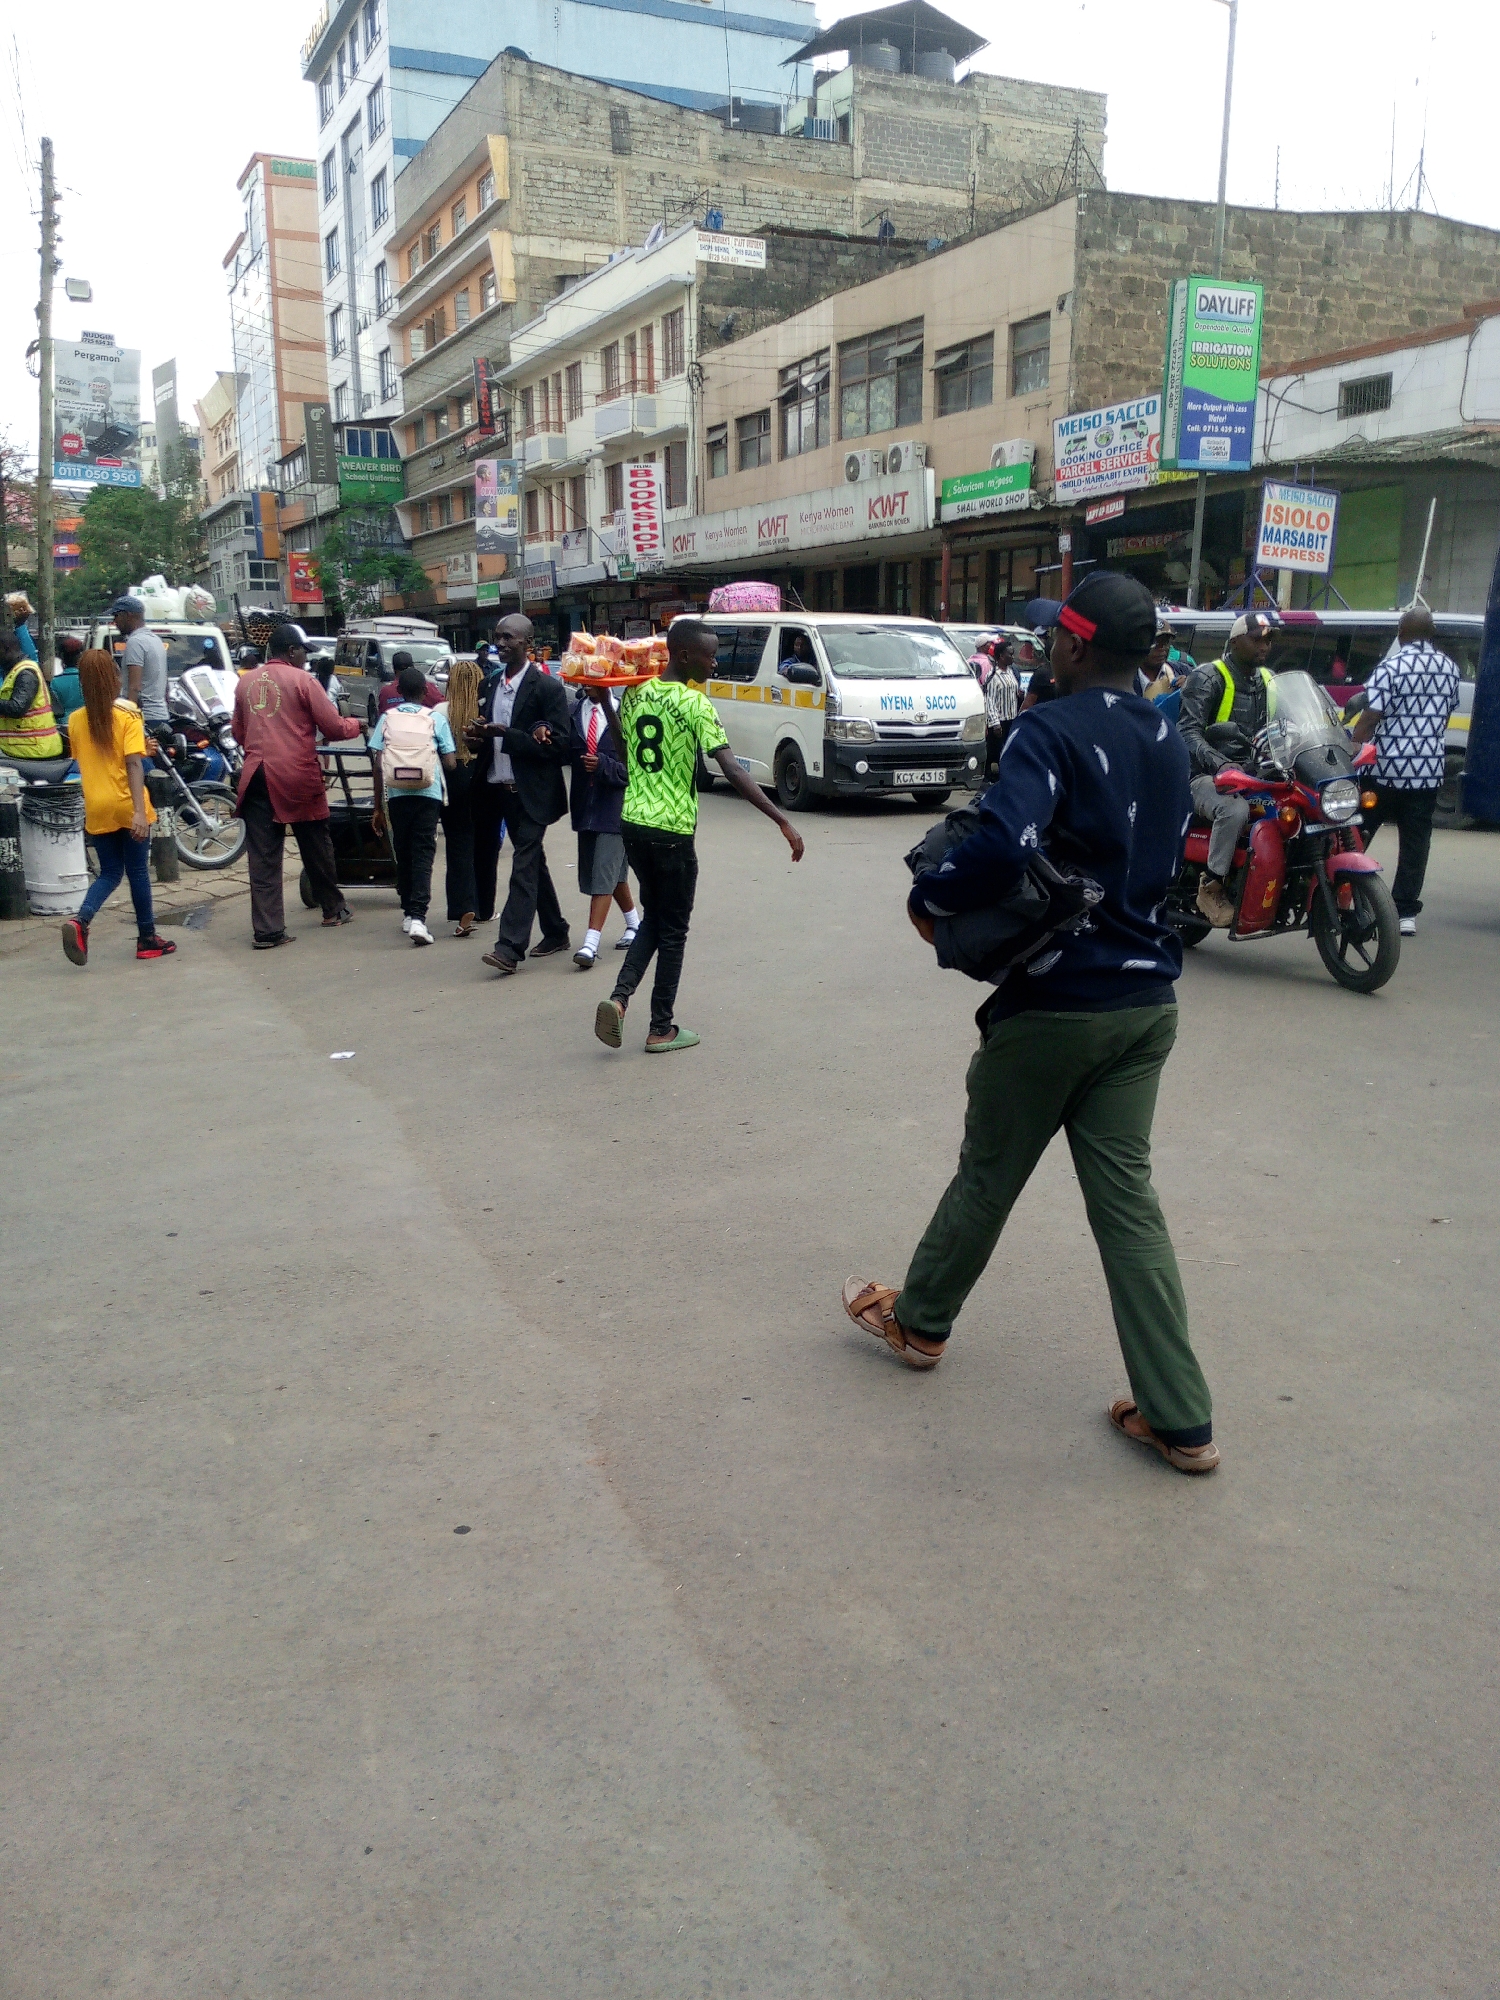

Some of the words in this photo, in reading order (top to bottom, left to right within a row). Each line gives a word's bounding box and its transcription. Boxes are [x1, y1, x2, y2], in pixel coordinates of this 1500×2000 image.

[1198, 293, 1254, 317] DAYLIFF
[1194, 322, 1230, 332] Dependable
[1232, 325, 1253, 335] Quality
[74, 350, 120, 363] Pergamon
[1191, 341, 1253, 357] IRRIGATION
[1190, 354, 1251, 370] SOLUTIONS
[1186, 402, 1202, 411] More
[1202, 403, 1222, 413] Output
[1223, 403, 1235, 412] with
[1235, 405, 1247, 413] Less
[1058, 413, 1102, 437] MEISO
[1105, 399, 1157, 426] SACCO
[1208, 414, 1227, 423] Water!
[1202, 425, 1219, 433] 0715
[314, 422, 326, 478] Delfirm
[1060, 449, 1102, 467] BOOKING
[1105, 440, 1143, 457] OFFICE
[341, 461, 379, 472] WEAVER
[380, 463, 402, 473] BIRD
[1060, 462, 1097, 480] PARCEL
[1100, 450, 1148, 471] SERVICE
[59, 466, 82, 478] 0111
[85, 469, 109, 480] 050
[111, 472, 136, 483] 950
[345, 473, 368, 481] School
[369, 473, 401, 483] Uniforms
[952, 480, 985, 495] Safaricom
[868, 490, 910, 520] KWFT
[979, 497, 1003, 510] WORLD
[1005, 493, 1025, 505] SHOP
[1279, 487, 1305, 504] MEISO
[1306, 492, 1334, 508] SACCO
[628, 468, 660, 553] BOOKSHOP
[800, 510, 822, 525] Kenya
[823, 505, 854, 519] Women
[1265, 503, 1331, 532] ISIOLO
[758, 514, 789, 539] KWFT
[887, 519, 894, 527] ON
[705, 530, 723, 541] Kenya
[723, 525, 748, 537] Women
[1262, 524, 1328, 551] MARSABIT
[672, 532, 696, 554] KWFT
[1261, 545, 1325, 563] EXPRESS
[880, 695, 914, 711] NYENA
[925, 695, 957, 710] SACCO
[624, 692, 690, 734] FERNANDES
[635, 714, 664, 774] 8
[896, 773, 915, 784] KCX
